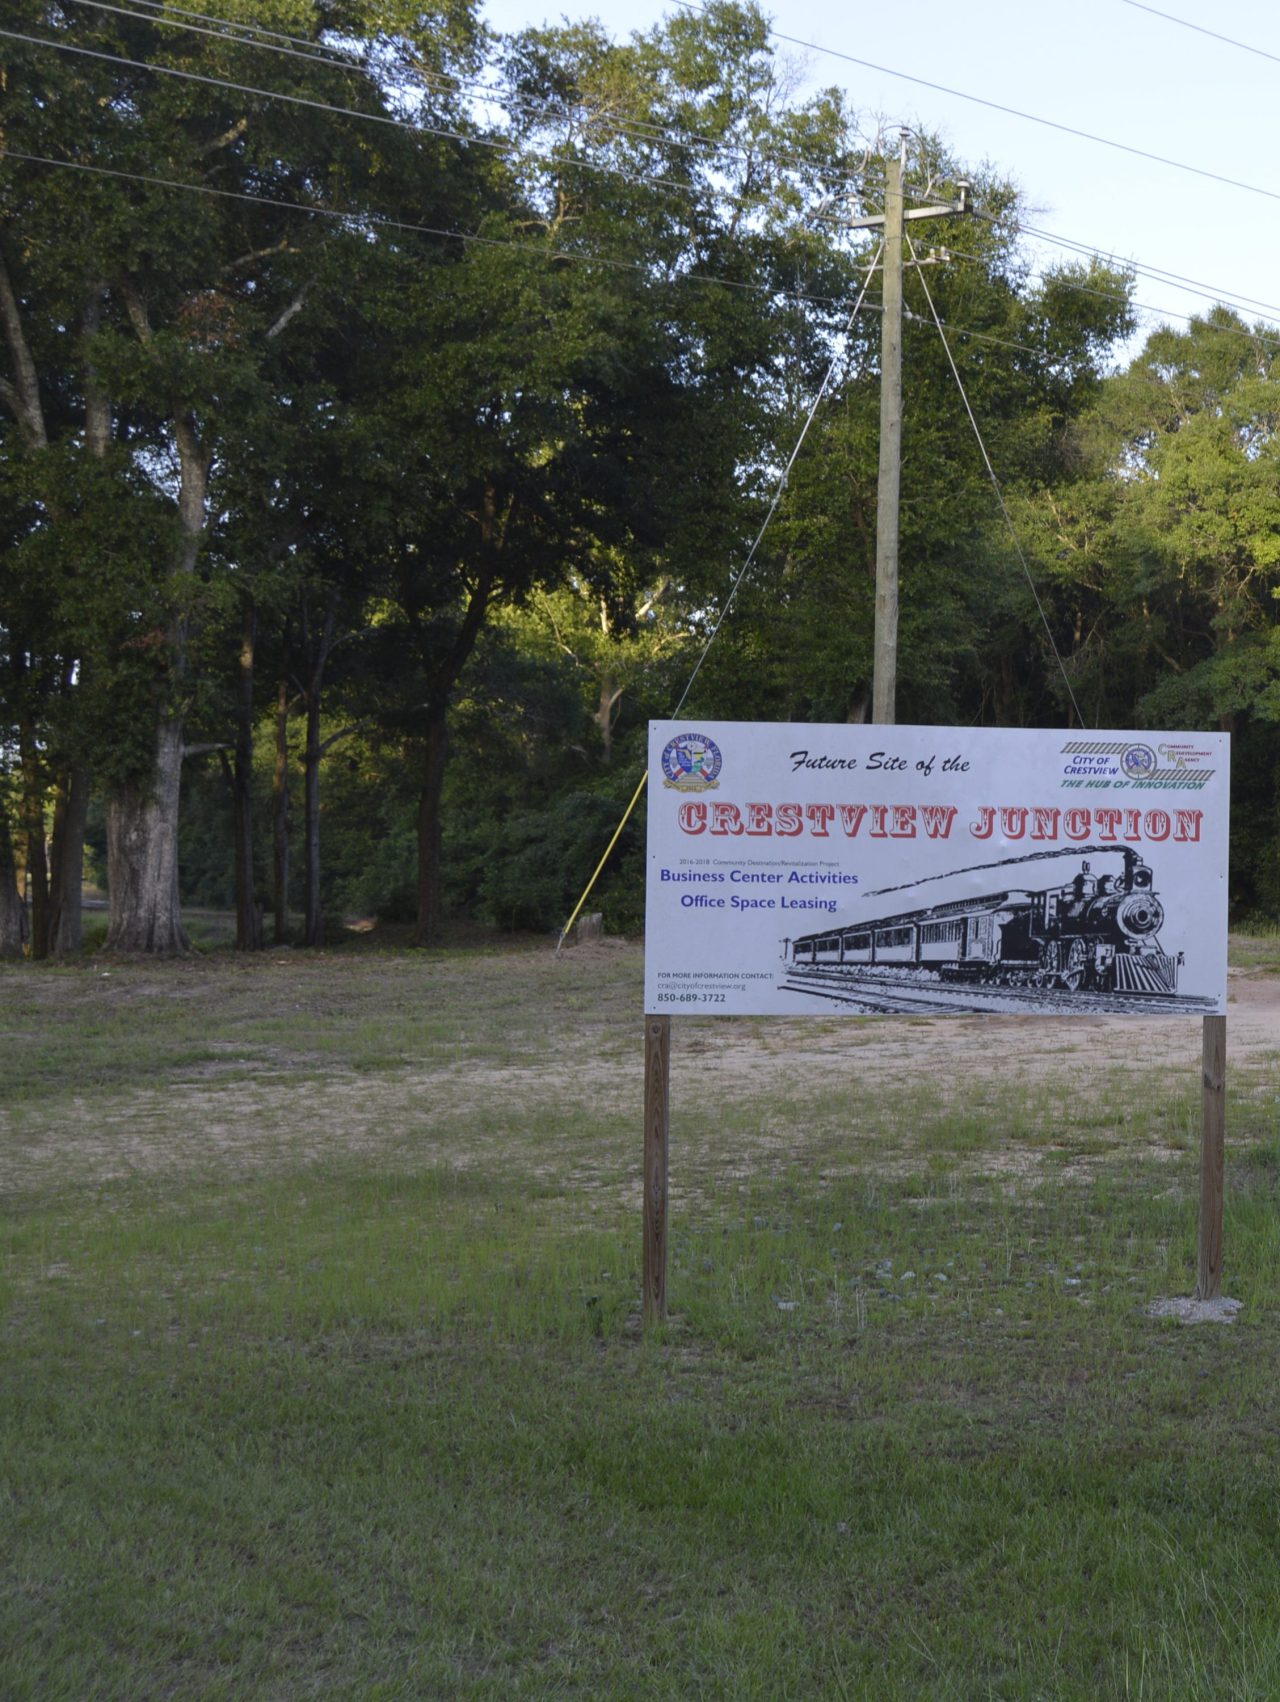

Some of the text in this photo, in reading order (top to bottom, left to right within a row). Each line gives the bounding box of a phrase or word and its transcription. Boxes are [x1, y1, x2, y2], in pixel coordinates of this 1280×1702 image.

[789, 750, 971, 777] Future Site of the
[1072, 755, 1111, 766] CITY OF
[1063, 765, 1119, 776] CRESTVIEW
[1060, 779, 1206, 791] THE HUB OF INNOVATION
[677, 801, 1205, 842] CRESTVIEW JUNCTION
[660, 869, 859, 885] Business Center Activities
[680, 894, 837, 913] Office Space Leasing
[657, 982, 746, 991] cra@cityofcrestview.org
[657, 993, 726, 1002] 850-689-3722
